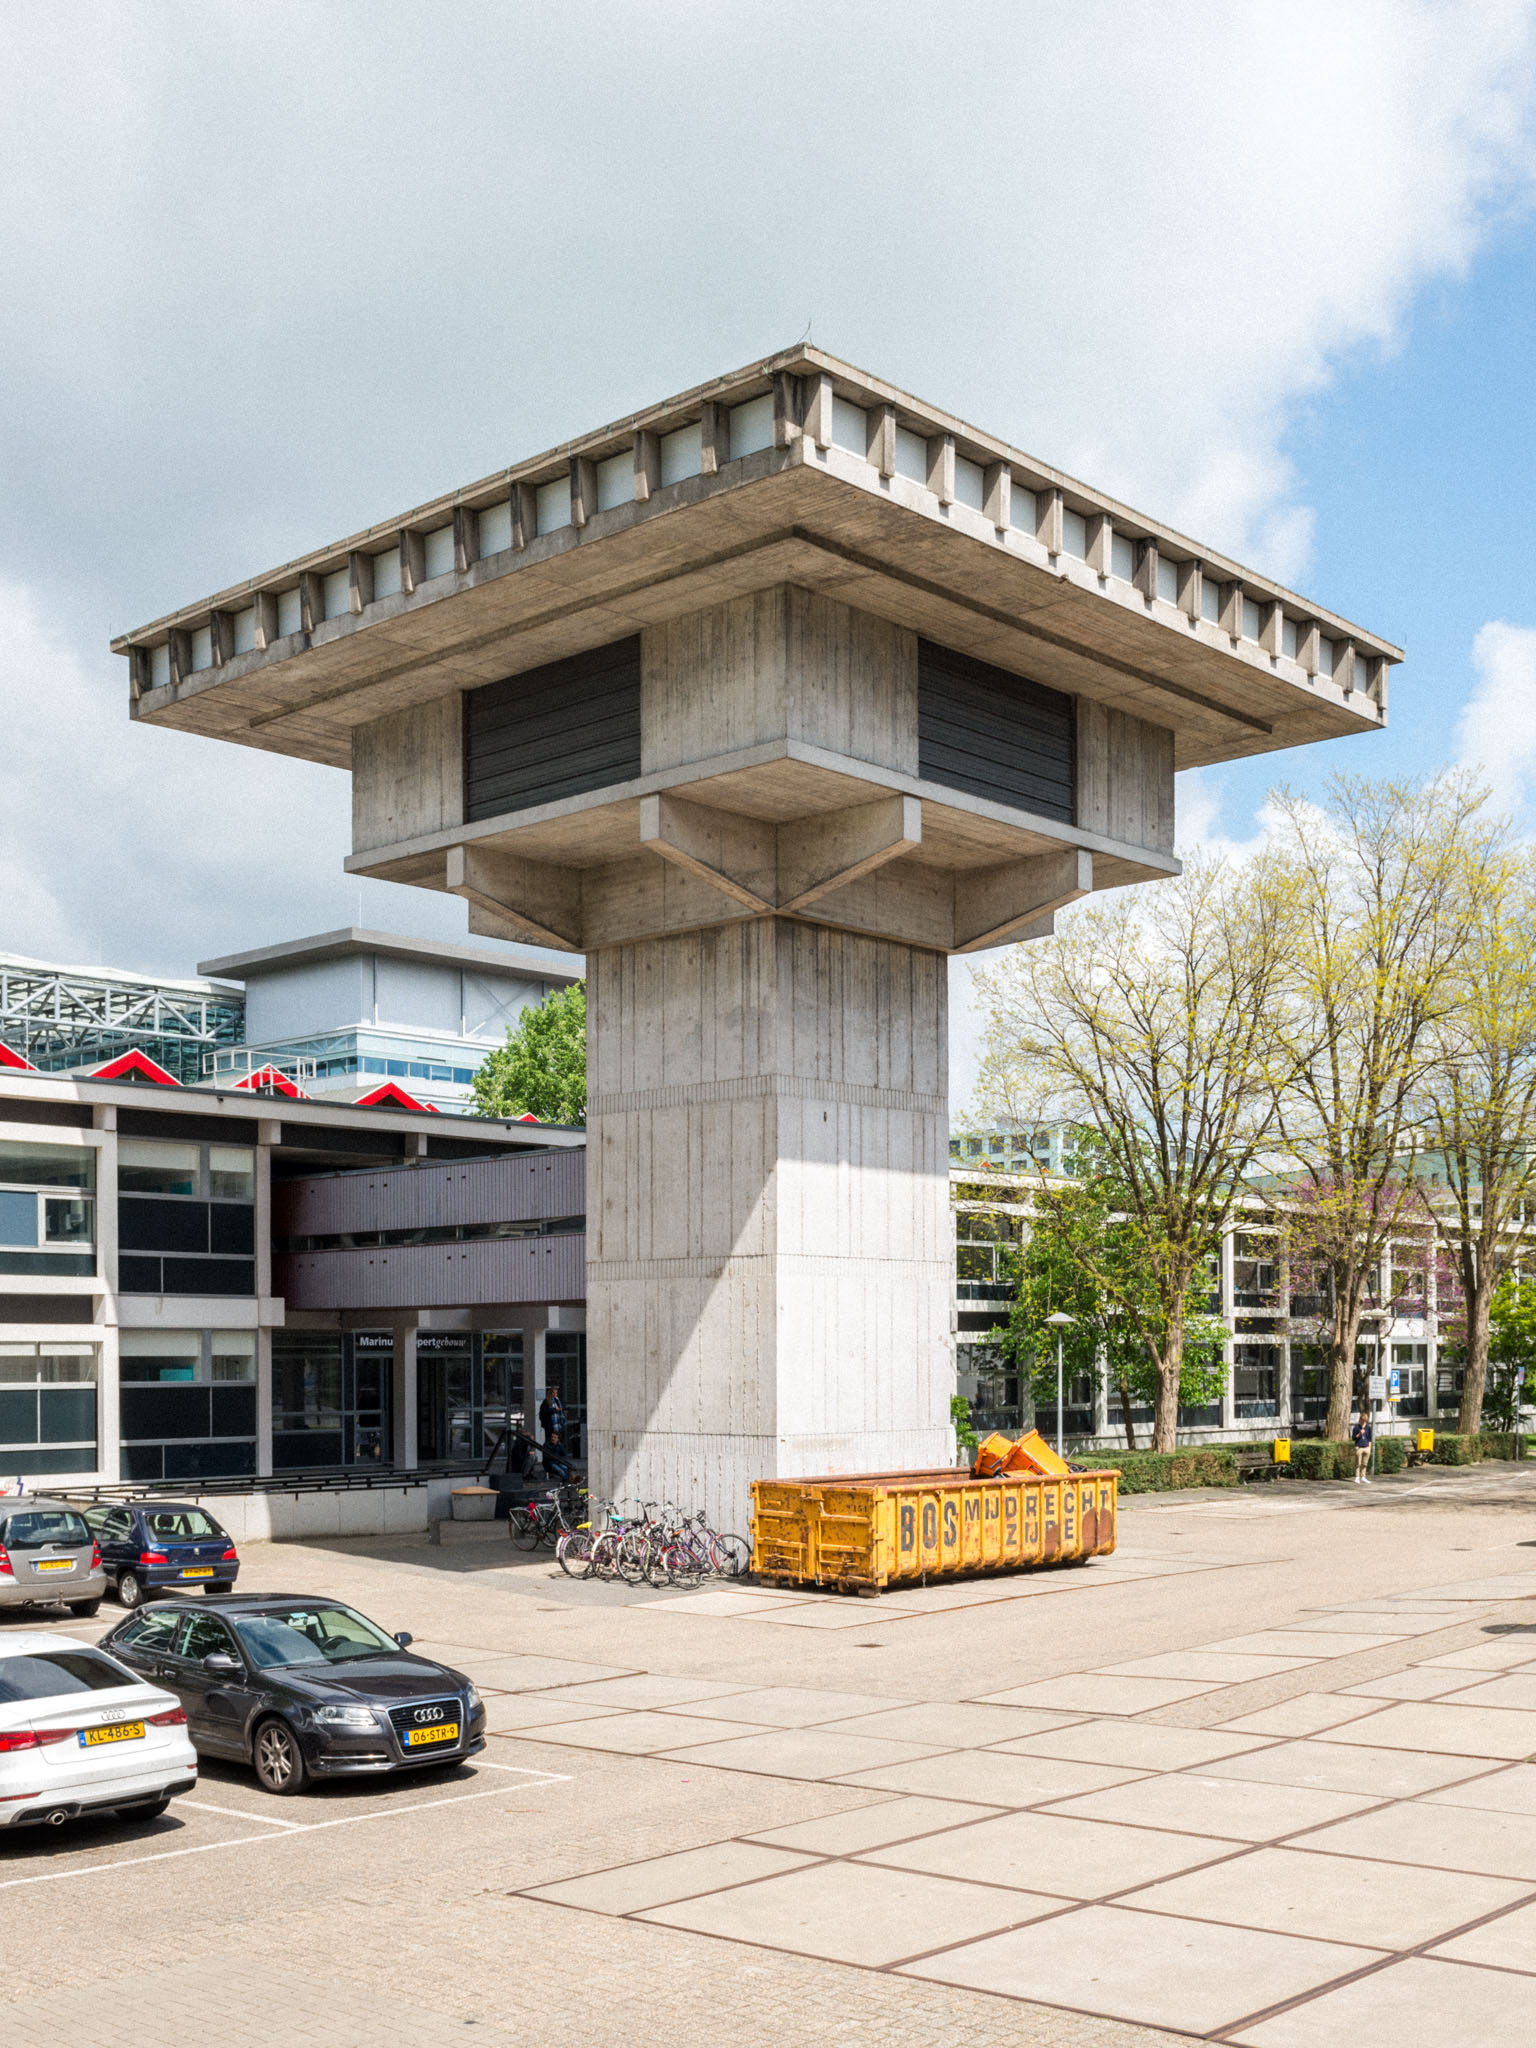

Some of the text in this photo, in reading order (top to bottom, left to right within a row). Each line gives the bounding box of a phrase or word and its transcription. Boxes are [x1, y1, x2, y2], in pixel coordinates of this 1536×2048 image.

[359, 1336, 466, 1349] Marinu pertgebouw
[901, 1489, 1109, 1552] BOS MIJDRECHT
[88, 1723, 141, 1743] KL-486-S
[413, 1726, 455, 1743] 06-STR-9
